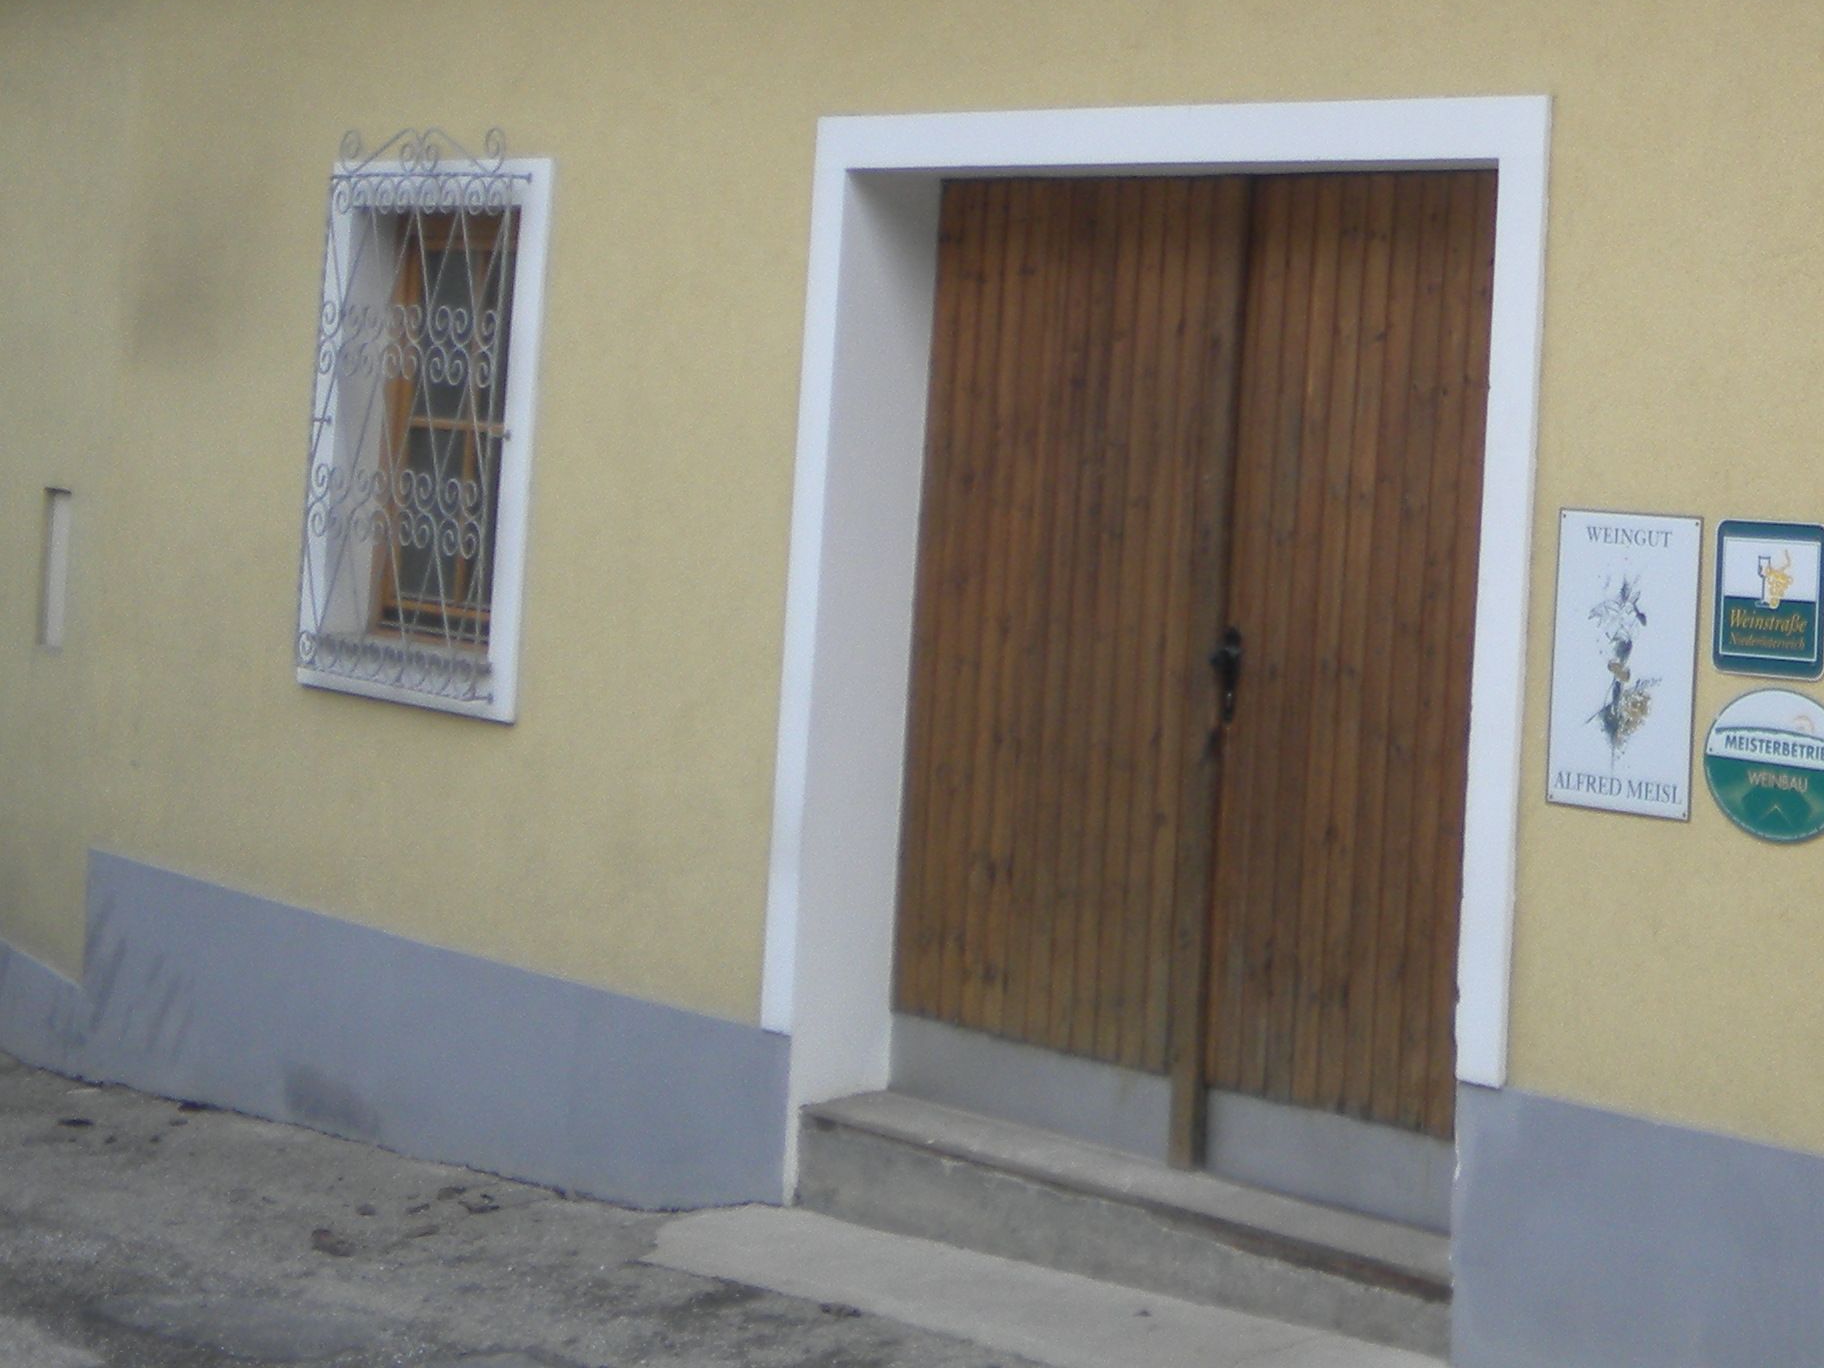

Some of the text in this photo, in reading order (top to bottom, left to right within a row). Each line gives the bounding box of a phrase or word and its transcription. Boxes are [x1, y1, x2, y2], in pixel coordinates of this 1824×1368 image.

[1586, 526, 1672, 548] WEINGUT
[1554, 770, 1682, 805] ALFRED MEISL
[1747, 770, 1808, 792] WEINBAU
